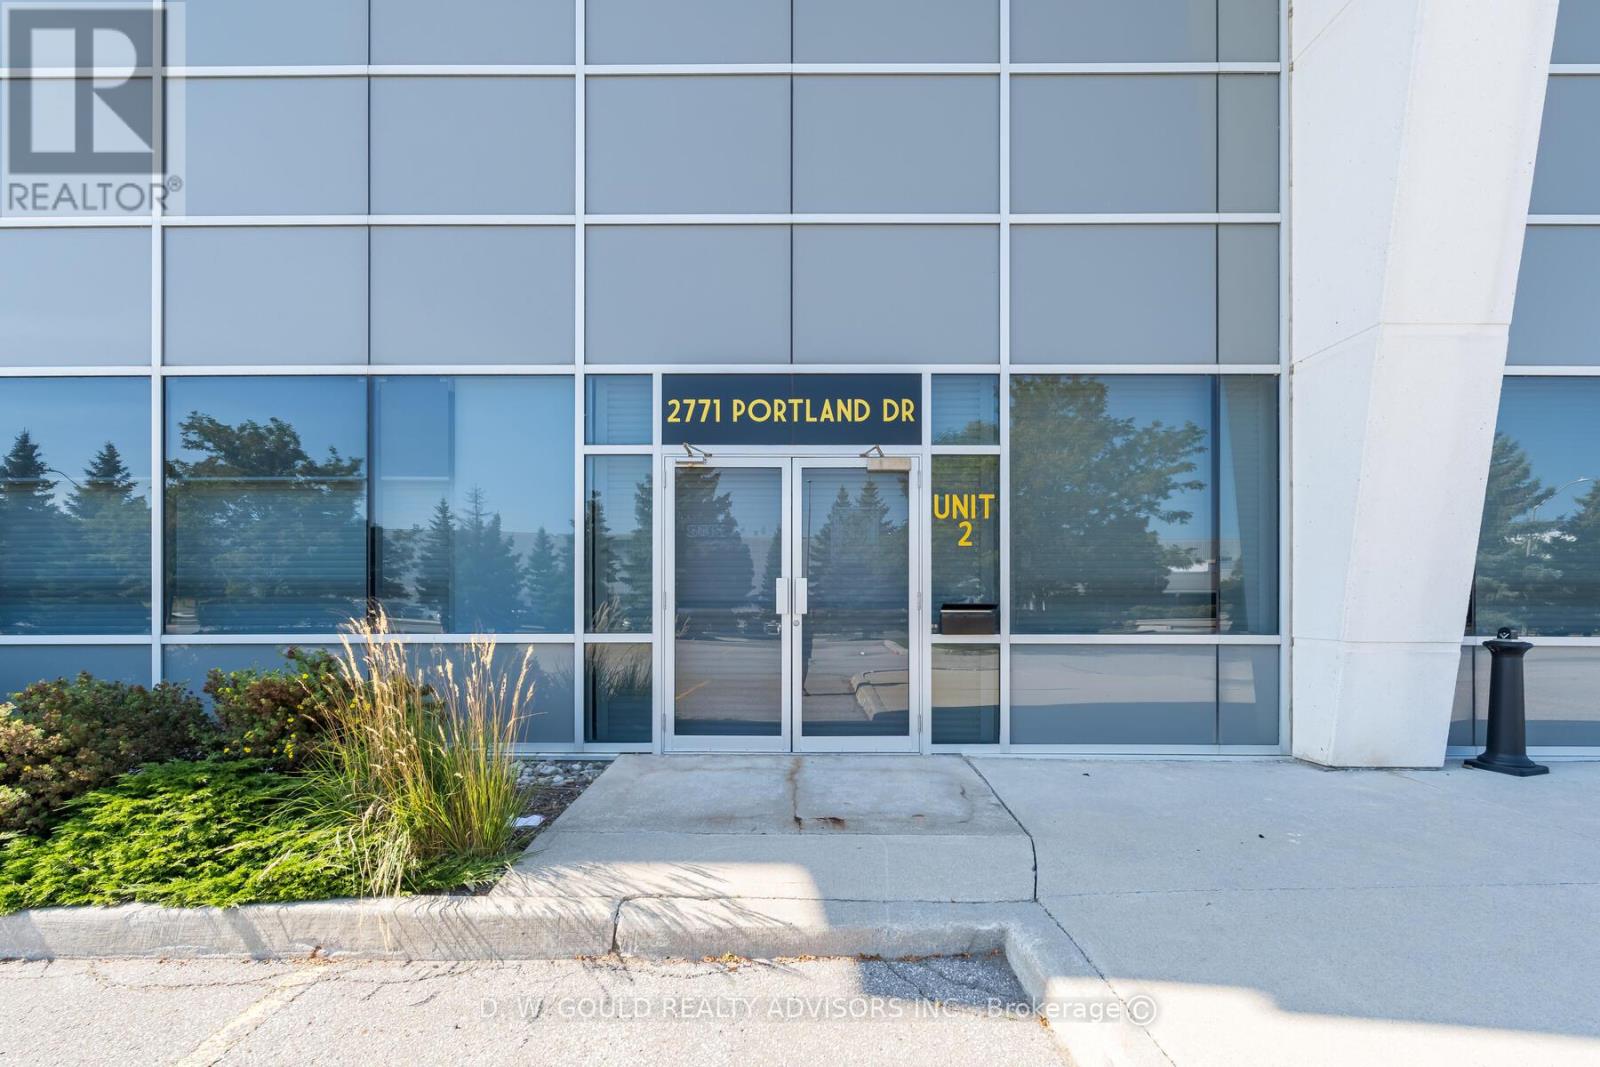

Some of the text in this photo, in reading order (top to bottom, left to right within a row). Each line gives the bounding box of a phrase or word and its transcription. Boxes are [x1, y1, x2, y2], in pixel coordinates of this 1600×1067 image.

[667, 398, 916, 423] 2771 PORTLAND DR
[933, 494, 995, 520] UNIT
[957, 521, 973, 547] 2
